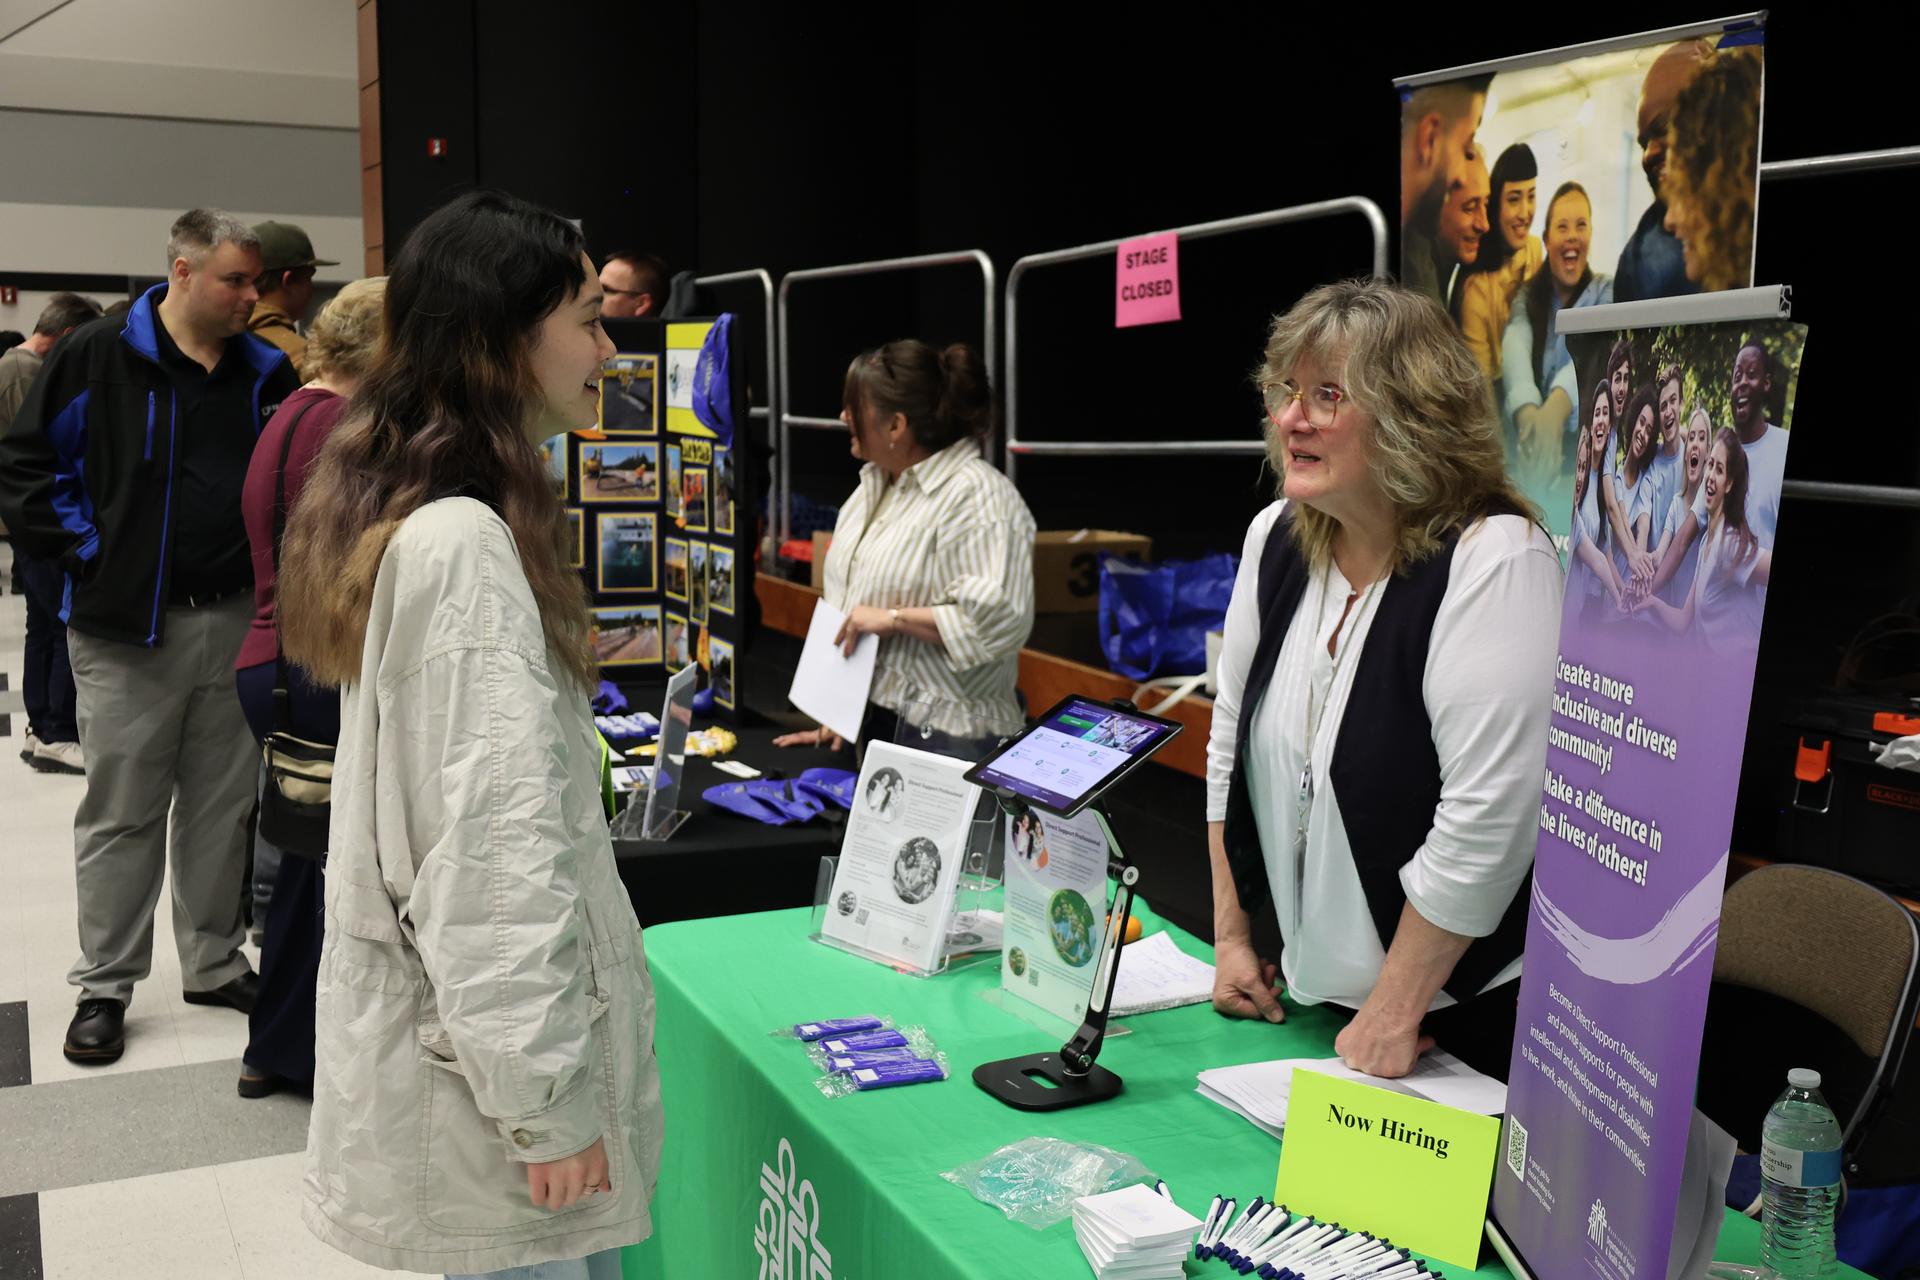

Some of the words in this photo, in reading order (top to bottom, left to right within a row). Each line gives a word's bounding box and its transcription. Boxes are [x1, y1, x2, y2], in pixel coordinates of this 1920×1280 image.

[1121, 279, 1173, 301] CLOSED
[1126, 247, 1168, 269] STAGE
[1556, 655, 1591, 689] Create
[1593, 673, 1600, 692] a
[1601, 676, 1634, 705] more
[1549, 726, 1613, 775] community!
[1552, 685, 1600, 728] inclusive
[1600, 712, 1624, 739] and
[1626, 716, 1677, 760] diverse
[1540, 804, 1556, 834] the
[1557, 812, 1586, 850] lives
[1587, 832, 1599, 858] of
[1598, 843, 1648, 886] others!
[1543, 768, 1573, 805] Make
[1575, 790, 1583, 809] a
[1585, 789, 1648, 844] difference
[1649, 820, 1662, 853] in
[1547, 1012, 1560, 1029] and
[1559, 1022, 1580, 1049] provide
[1578, 1042, 1605, 1073] supports
[1605, 1062, 1617, 1081] for
[1616, 1075, 1639, 1104] people
[1639, 1094, 1654, 1118] with
[1549, 983, 1573, 1013] Become
[1576, 1006, 1592, 1032] Direct
[1591, 1021, 1620, 1054] Support
[1620, 1042, 1658, 1088] Professional
[1522, 1043, 1528, 1057] to
[1528, 1047, 1540, 1070] live,
[1541, 1061, 1556, 1085] work,
[1556, 1076, 1568, 1094] and
[1567, 1085, 1581, 1111] thrive
[1581, 1100, 1588, 1118] in
[1588, 1107, 1604, 1131] their
[1605, 1126, 1647, 1177] communities.
[1530, 1023, 1563, 1060] intellectual
[1562, 1053, 1574, 1071] and
[1572, 1062, 1618, 1114] developmental
[1618, 1103, 1650, 1147] disabilities
[1327, 1103, 1374, 1133] Now
[1380, 1117, 1450, 1160] Hiring
